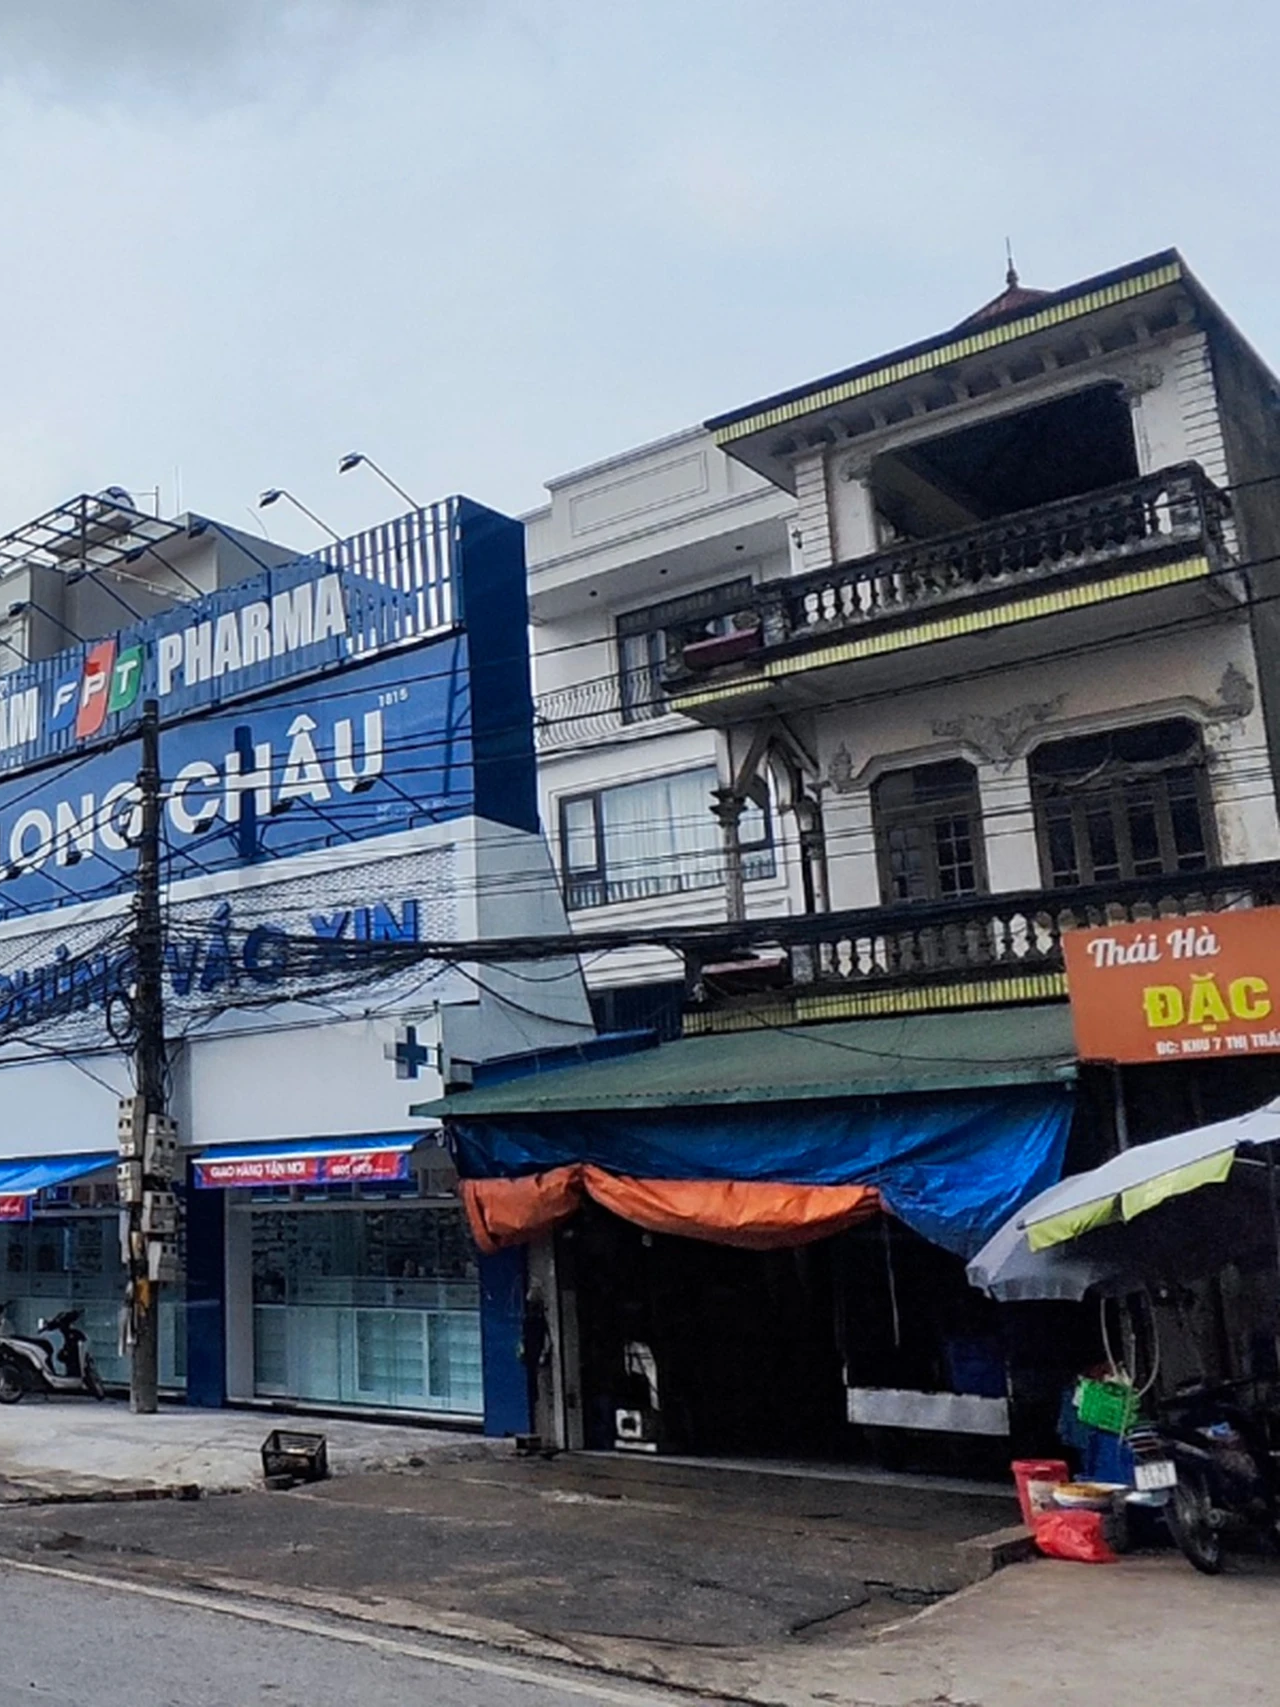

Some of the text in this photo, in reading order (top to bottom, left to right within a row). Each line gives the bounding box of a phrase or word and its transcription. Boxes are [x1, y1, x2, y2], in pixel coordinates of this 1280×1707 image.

[51, 655, 140, 726] FPT
[157, 573, 348, 696] PHARMA
[170, 714, 384, 834] CHÂU
[1087, 926, 1221, 968] Thái Hà
[1143, 972, 1272, 1032] ĐẶC
[1182, 1037, 1210, 1052] KHU
[1213, 1037, 1223, 1050] 7
[210, 1164, 235, 1178] GIAO
